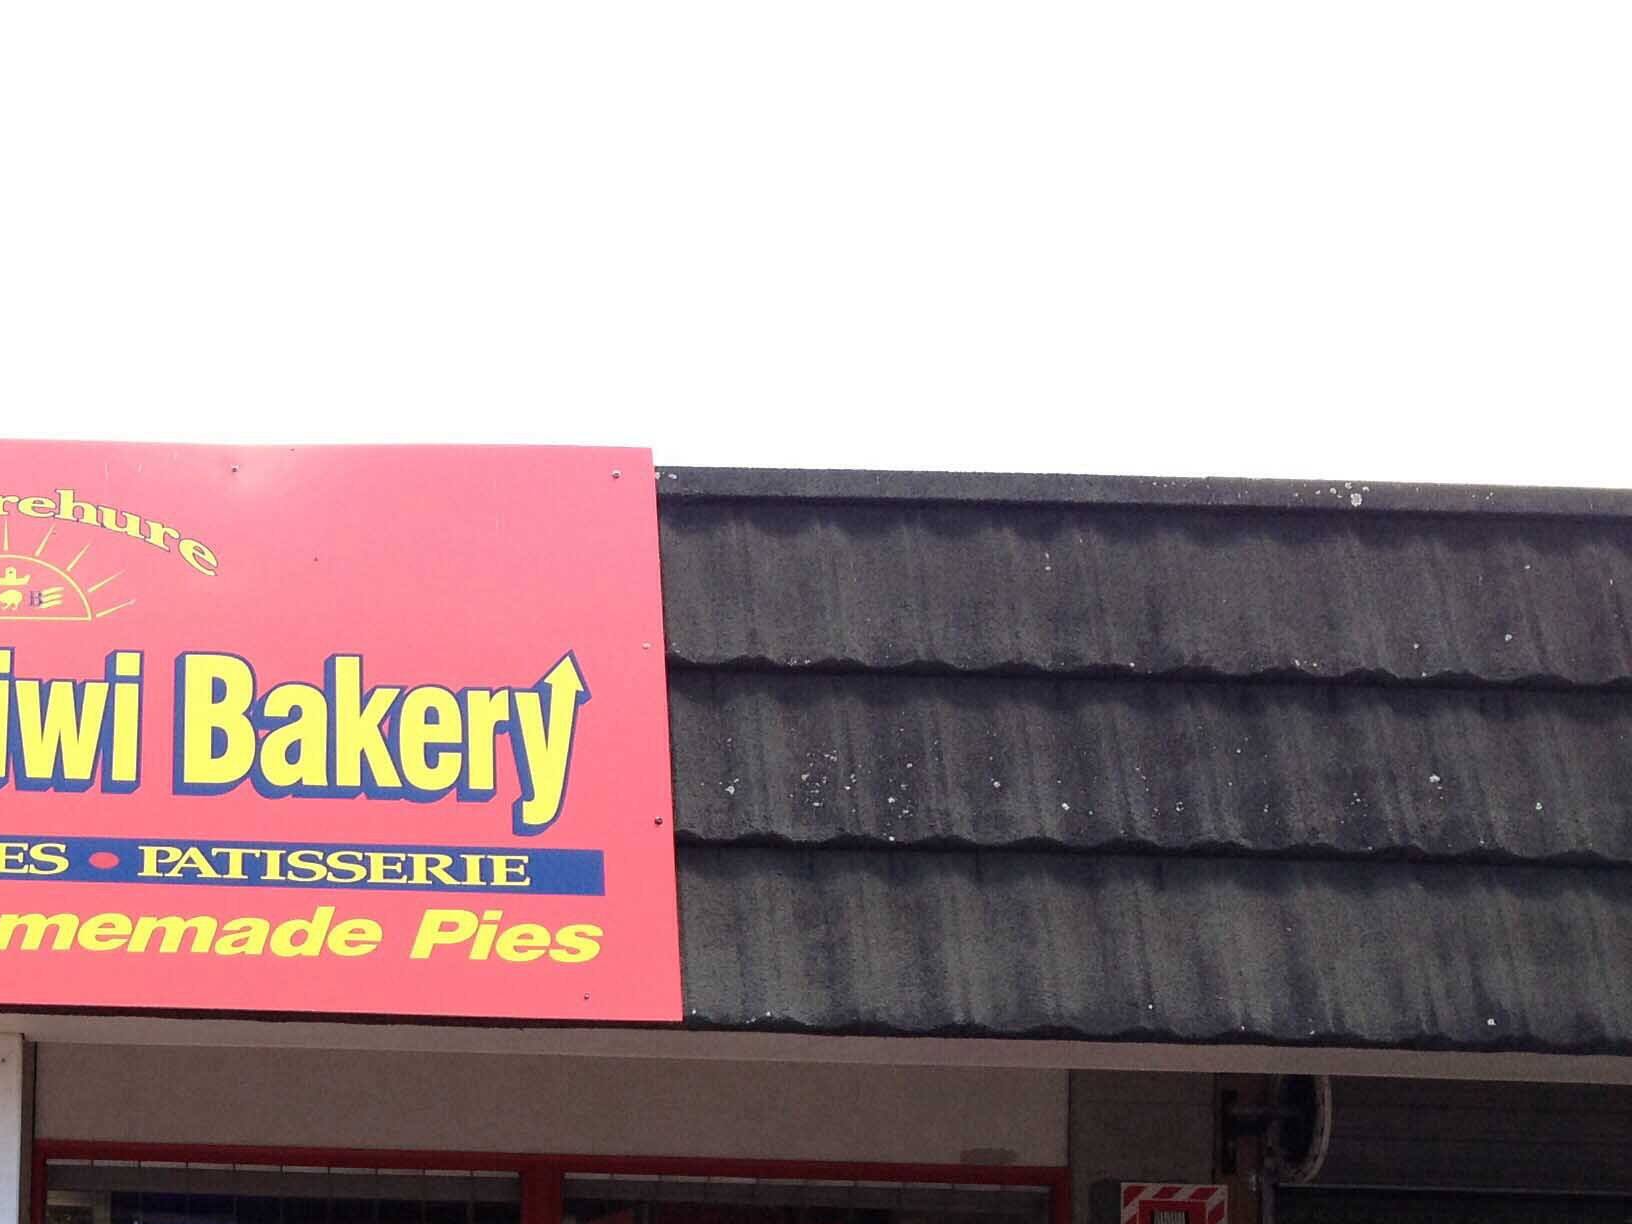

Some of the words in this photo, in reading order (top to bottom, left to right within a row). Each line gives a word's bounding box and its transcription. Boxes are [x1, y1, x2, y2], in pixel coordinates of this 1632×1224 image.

[173, 650, 590, 836] Bakery
[136, 845, 531, 887] PATISSERIE
[409, 908, 604, 964] Pies
